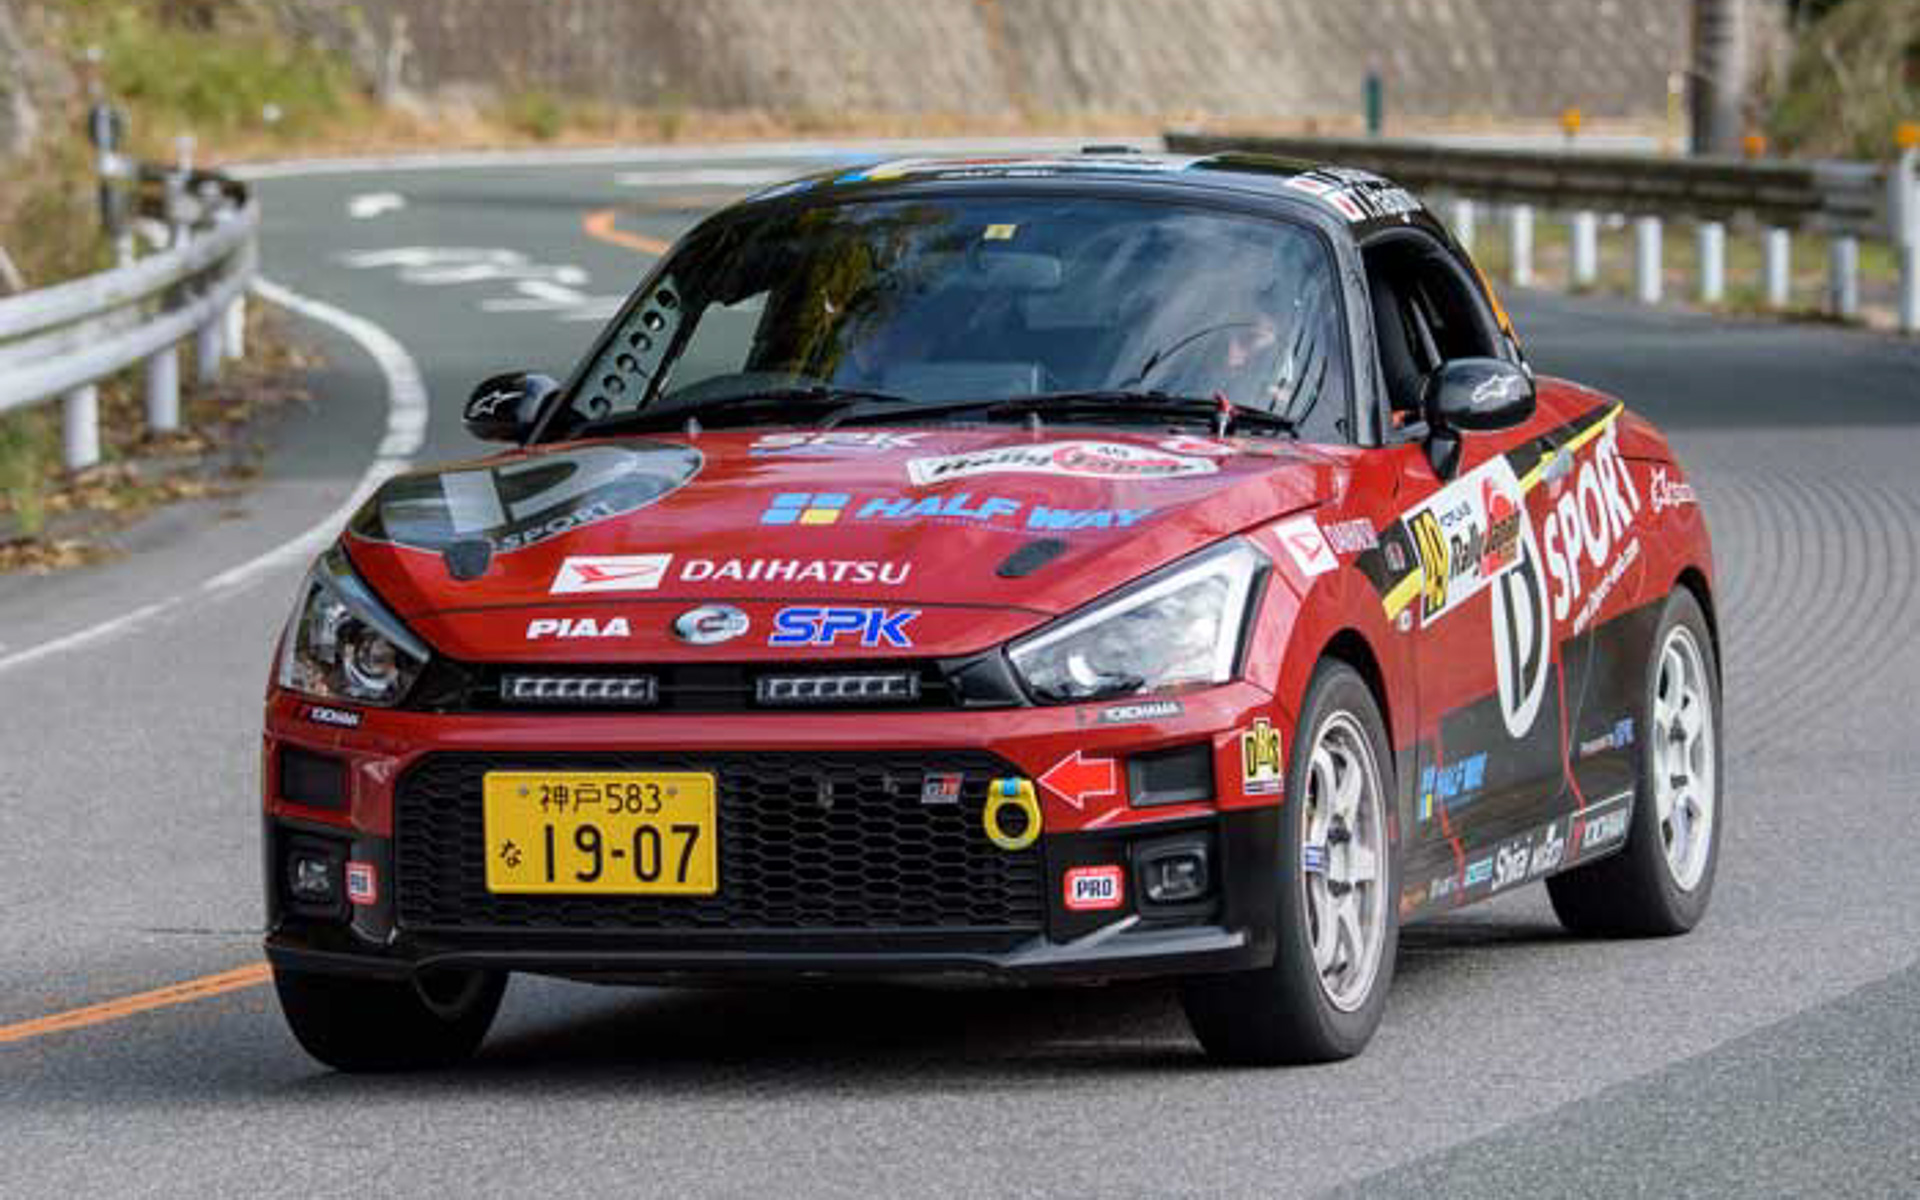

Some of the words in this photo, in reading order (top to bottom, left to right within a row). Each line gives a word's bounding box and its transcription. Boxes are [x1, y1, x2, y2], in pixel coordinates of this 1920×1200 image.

[856, 492, 1021, 521] HALF
[1026, 506, 1155, 531] WAY
[1544, 420, 1641, 620] SPORT
[680, 559, 911, 585] DAIHATSU
[526, 617, 631, 640] PIAA
[767, 606, 921, 647] SPK
[499, 839, 522, 868] な
[544, 824, 699, 883] 19-07
[1076, 878, 1113, 898] PRO
